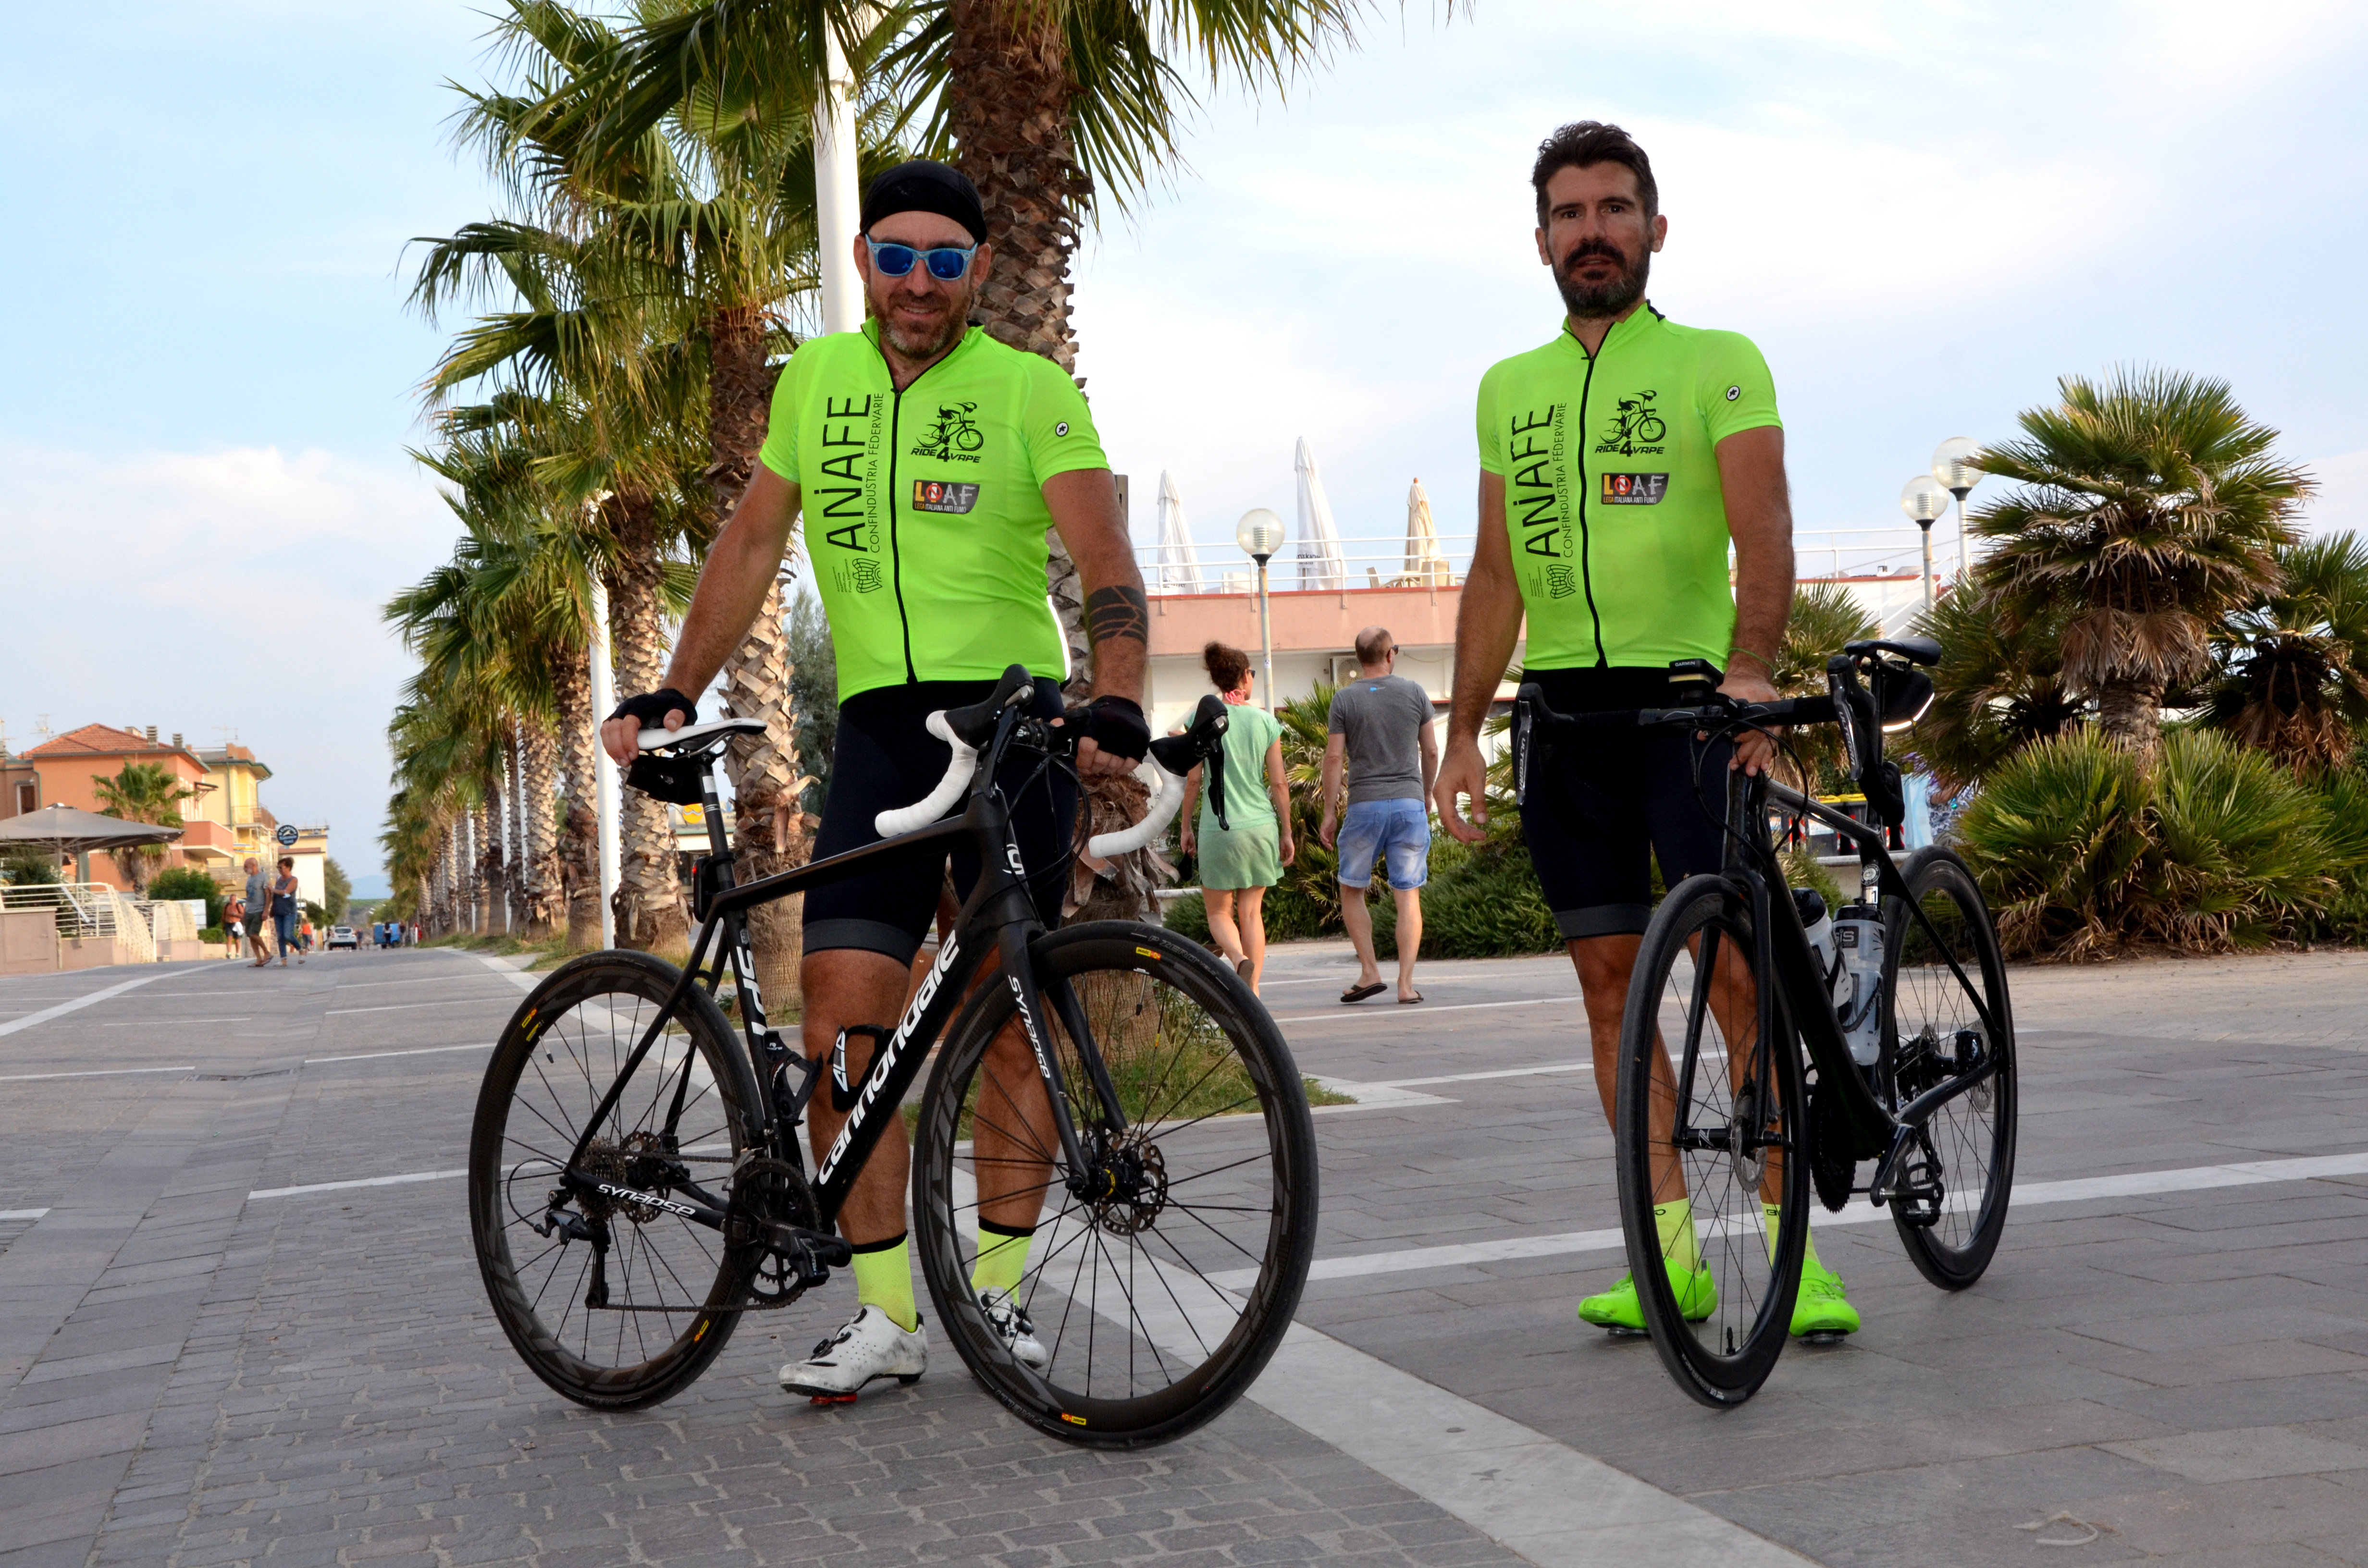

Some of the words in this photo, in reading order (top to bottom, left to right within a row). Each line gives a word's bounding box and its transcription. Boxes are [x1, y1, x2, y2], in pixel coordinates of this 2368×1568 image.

[868, 393, 884, 455] FEDERVARIE
[1553, 403, 1567, 462] FEDERVARIE
[865, 459, 880, 553] CONFINDUSTRIA
[1556, 465, 1574, 558] CONFINDUSTRIA
[1839, 711, 1855, 766] ULTEGRA
[818, 929, 960, 1185] cannondale
[1008, 975, 1051, 1078] synapse
[596, 1184, 696, 1217] synapse
